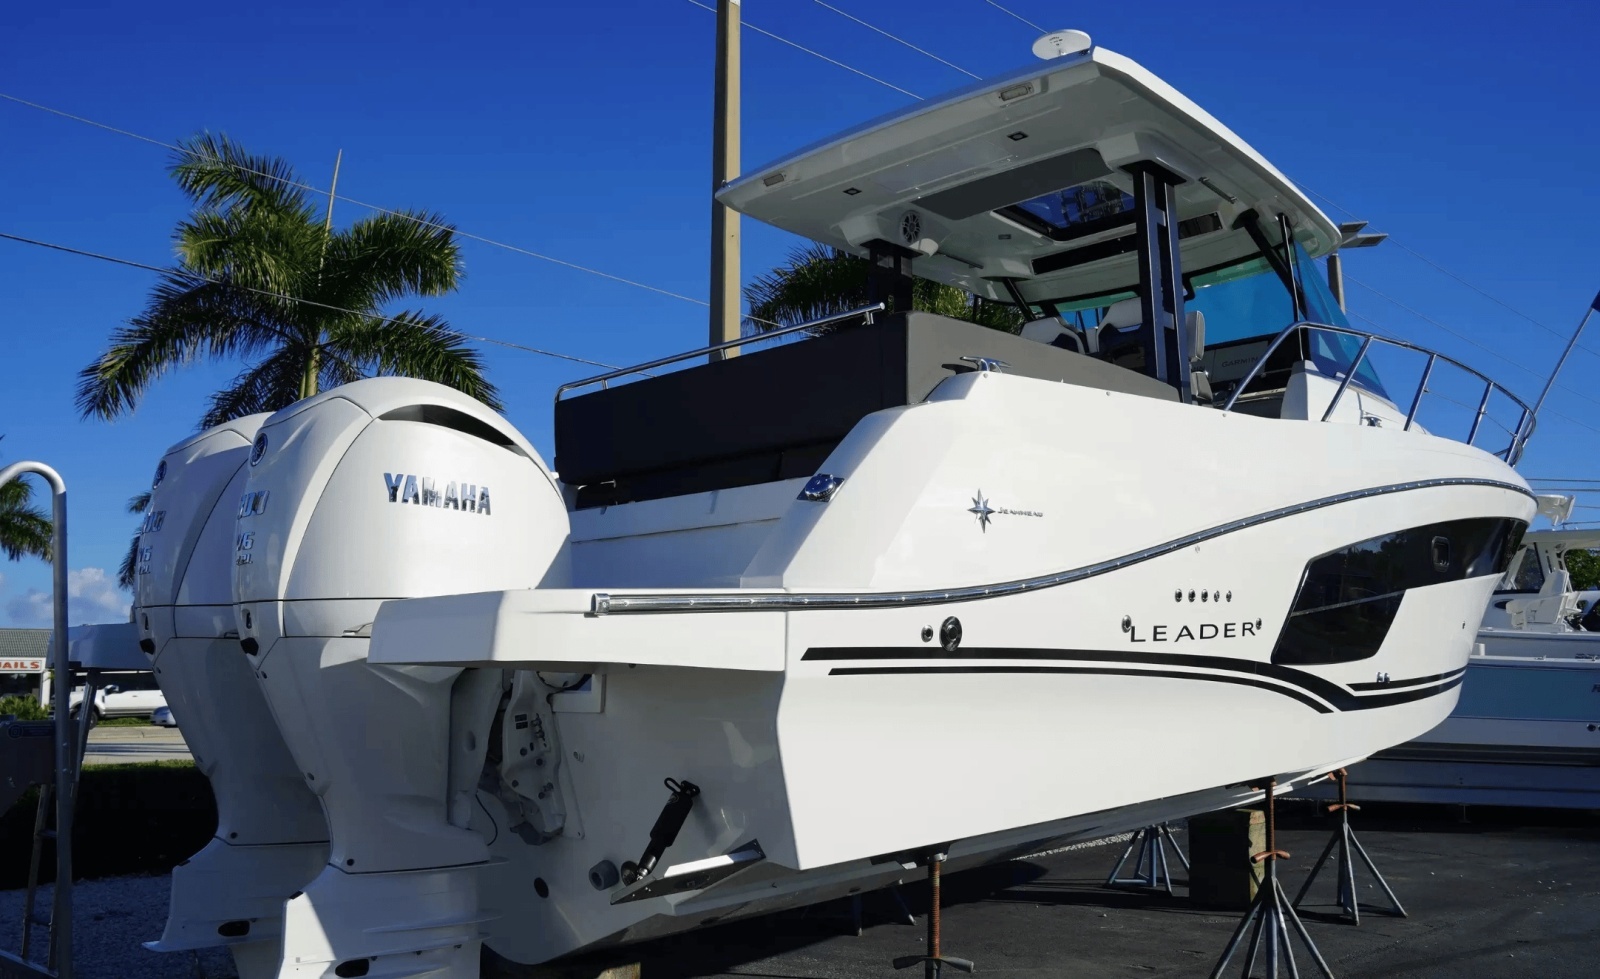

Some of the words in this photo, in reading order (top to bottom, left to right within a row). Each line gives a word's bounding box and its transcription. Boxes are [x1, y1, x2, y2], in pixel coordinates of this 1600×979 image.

[1221, 356, 1259, 368] GARMIN
[383, 472, 491, 516] YAMAHA
[1130, 621, 1256, 643] LEADER
